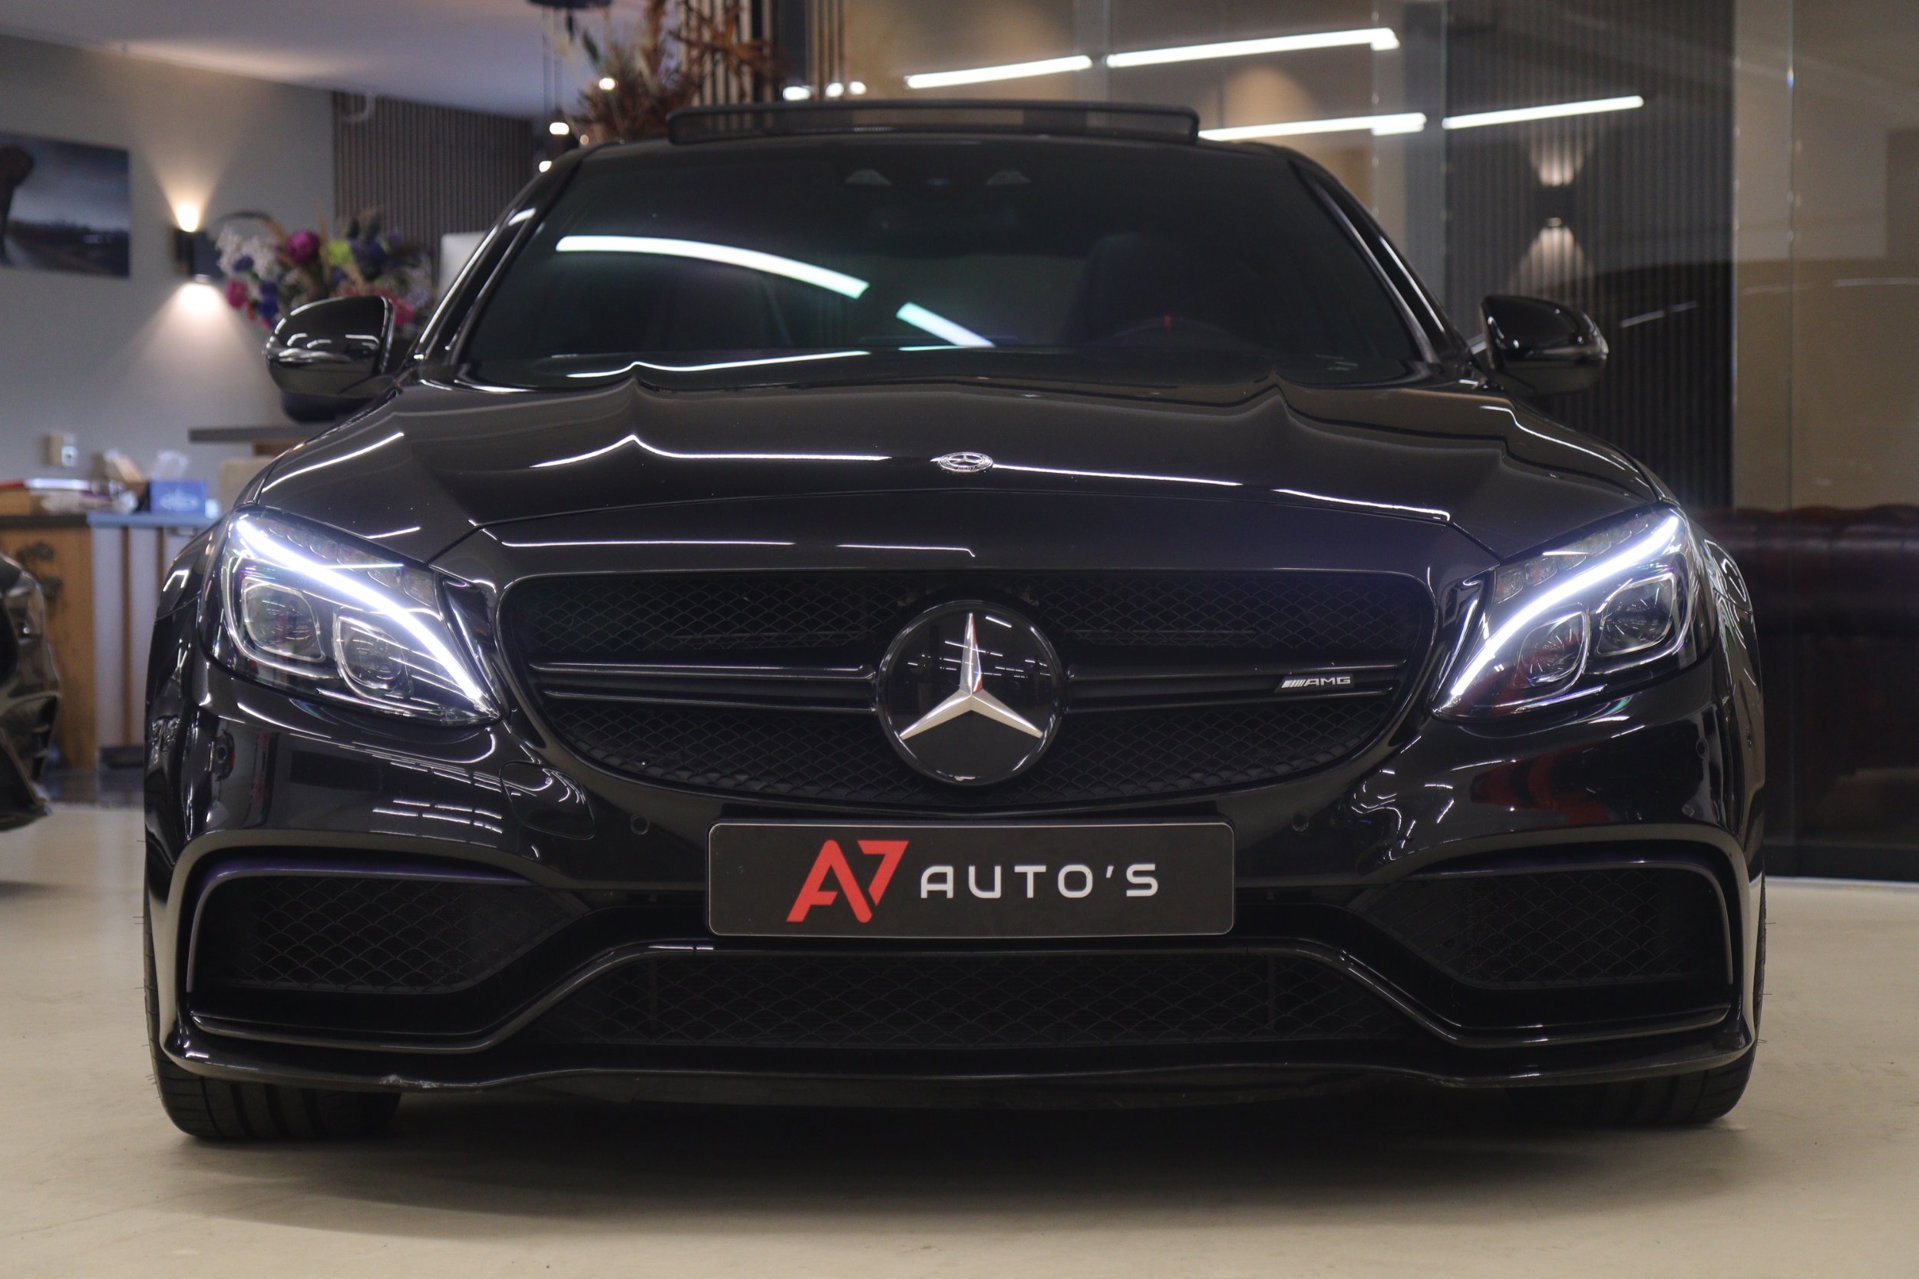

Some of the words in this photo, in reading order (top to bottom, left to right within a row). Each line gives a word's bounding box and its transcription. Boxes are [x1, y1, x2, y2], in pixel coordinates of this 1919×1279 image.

[1302, 676, 1351, 687] AMG
[786, 839, 909, 923] A7
[920, 863, 1158, 898] AUTO'S
